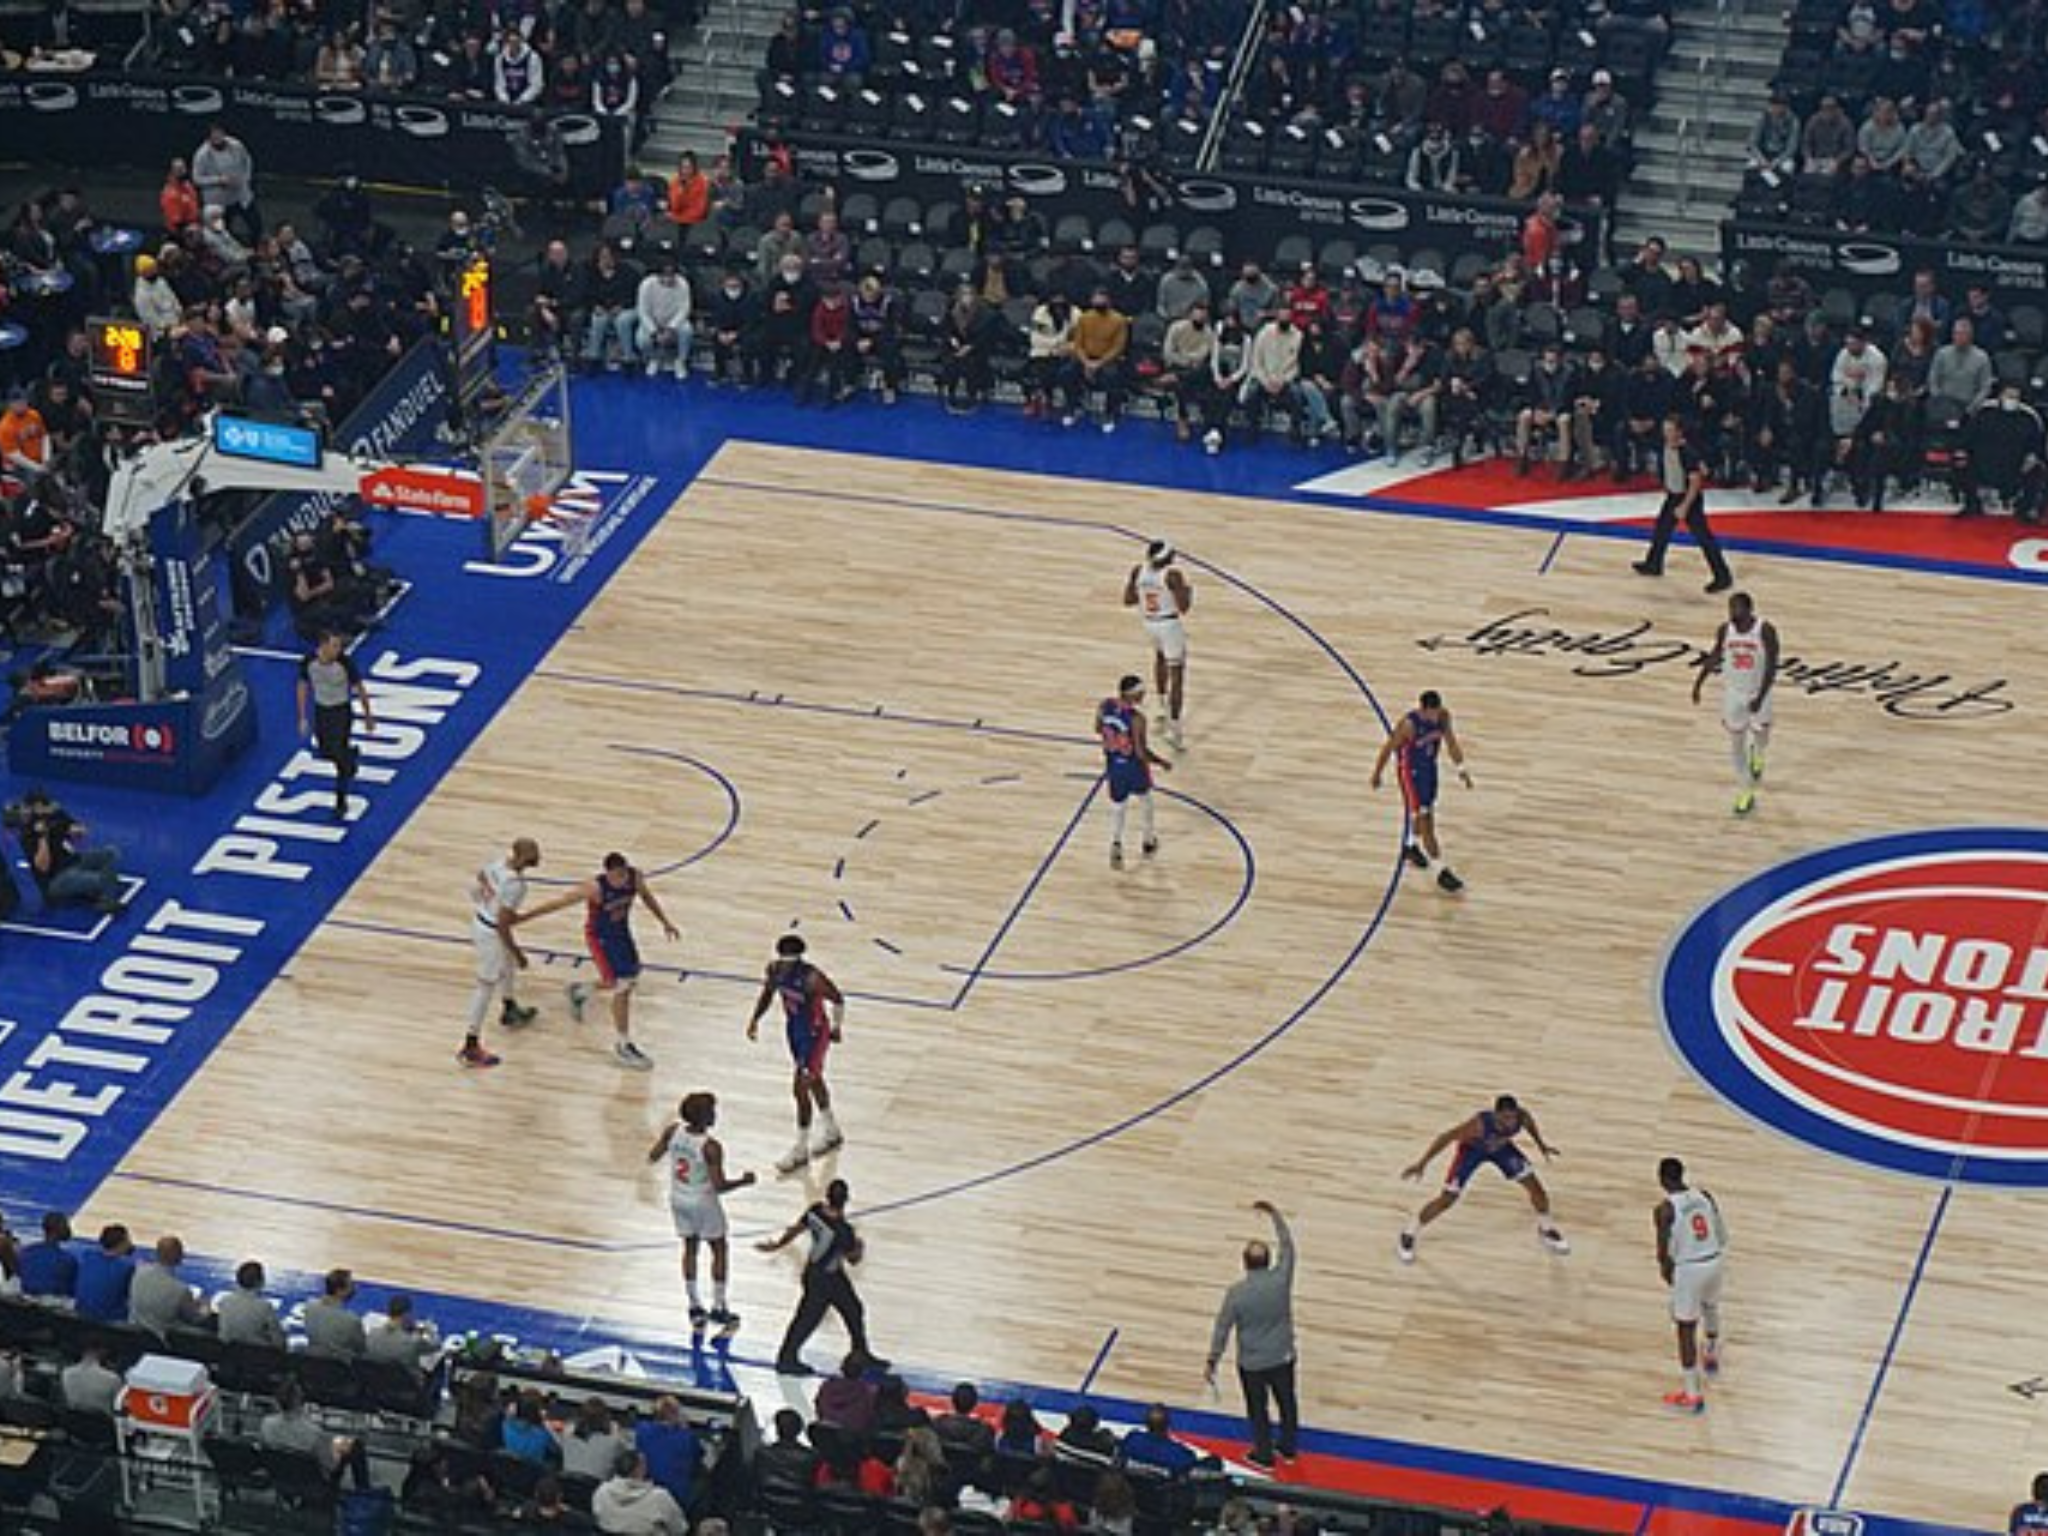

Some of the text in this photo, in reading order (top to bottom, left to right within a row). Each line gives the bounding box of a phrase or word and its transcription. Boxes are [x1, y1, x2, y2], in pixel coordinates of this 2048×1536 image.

[48, 721, 129, 746] BELFOR
[0, 899, 266, 1162] DETROIT
[192, 651, 482, 881] PISTONS
